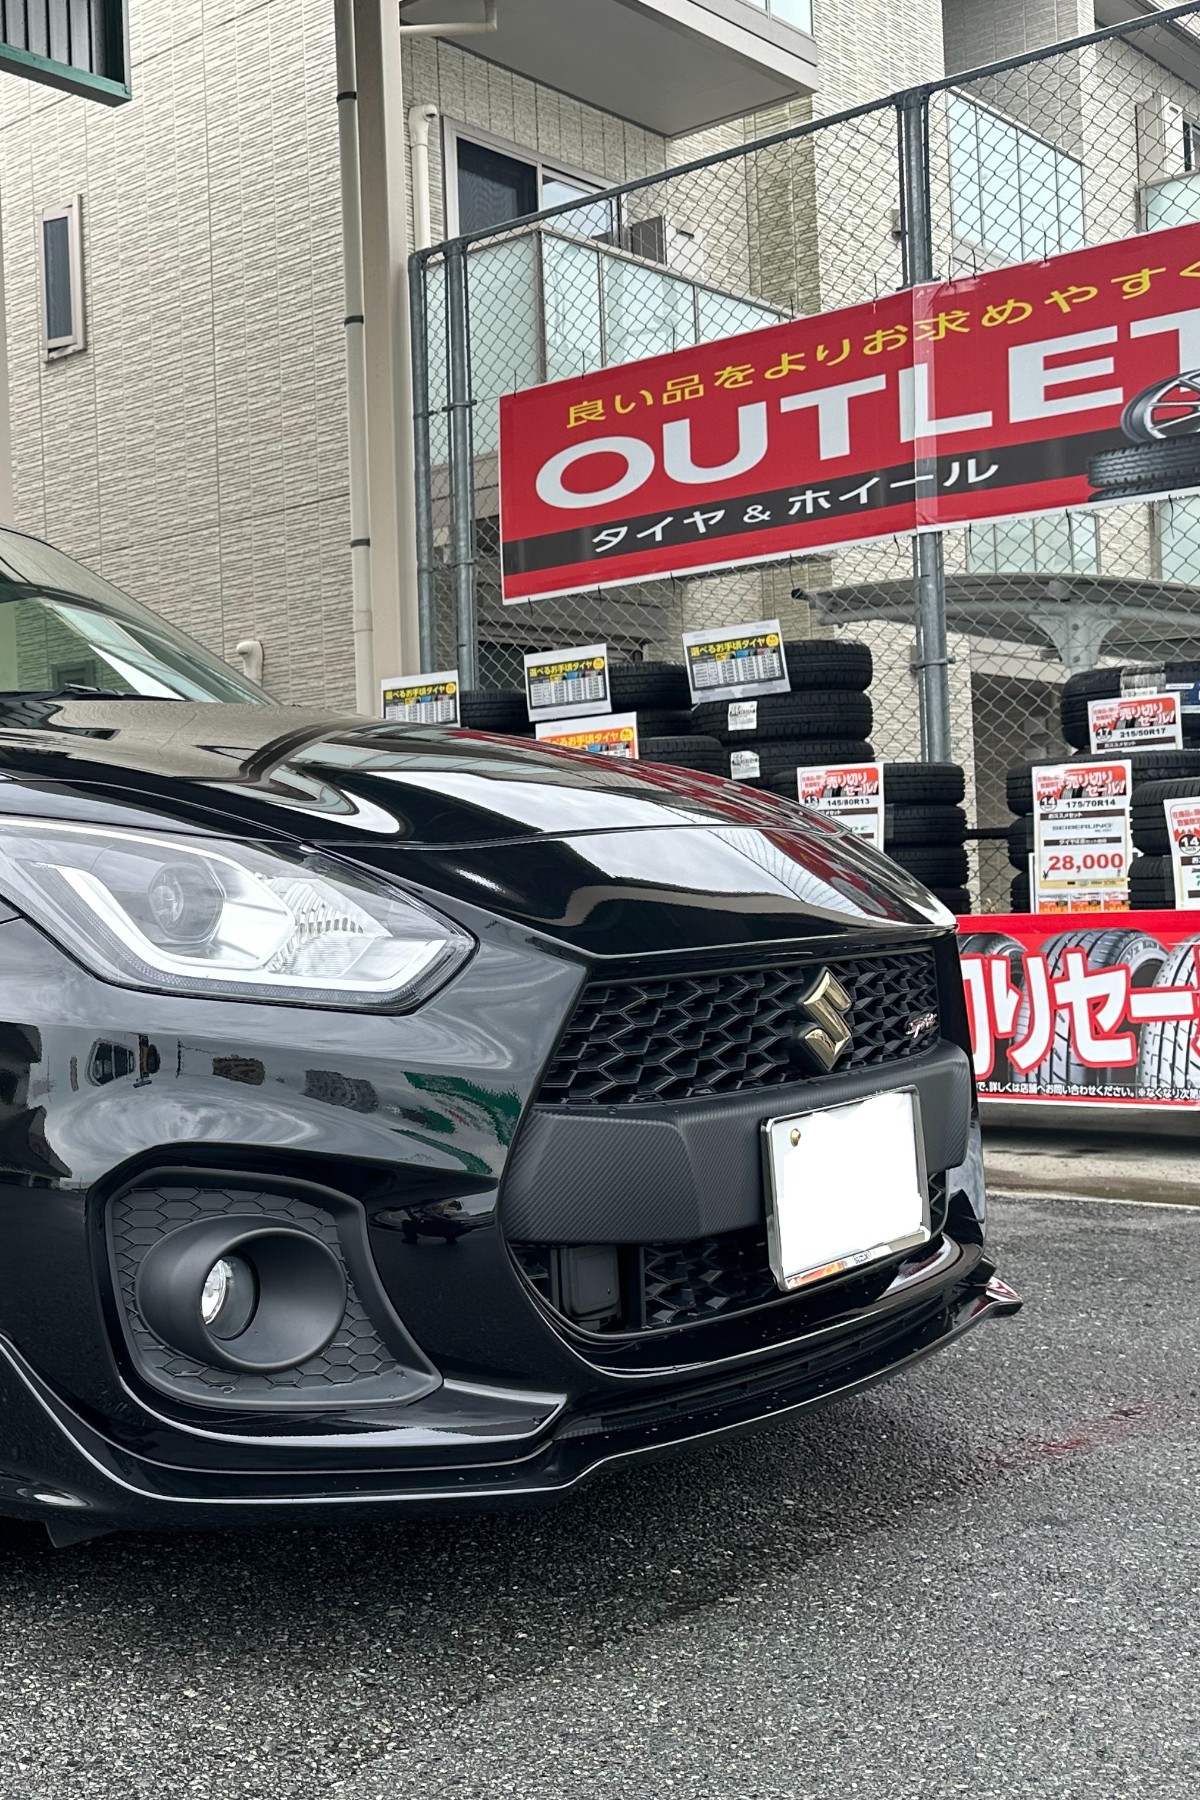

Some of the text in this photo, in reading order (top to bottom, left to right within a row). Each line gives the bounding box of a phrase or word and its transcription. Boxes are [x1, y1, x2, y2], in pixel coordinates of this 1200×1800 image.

[592, 458, 999, 552] タイヤ & ホイール
[690, 637, 765, 657] 選べるお手頃タイヤ
[1117, 702, 1163, 720] 売り切り
[1138, 710, 1175, 726] セール!
[1120, 728, 1166, 738] 215/50R17
[826, 772, 868, 789] 売り切り
[1064, 771, 1113, 789] 売り切り
[844, 781, 878, 796] セール!
[1086, 780, 1126, 797] セール!
[827, 798, 870, 807] 145/80R13
[1041, 797, 1056, 806] 14
[1066, 799, 1116, 809] 175/70R14
[1181, 836, 1200, 847] 14
[1048, 853, 1124, 873] 28,000
